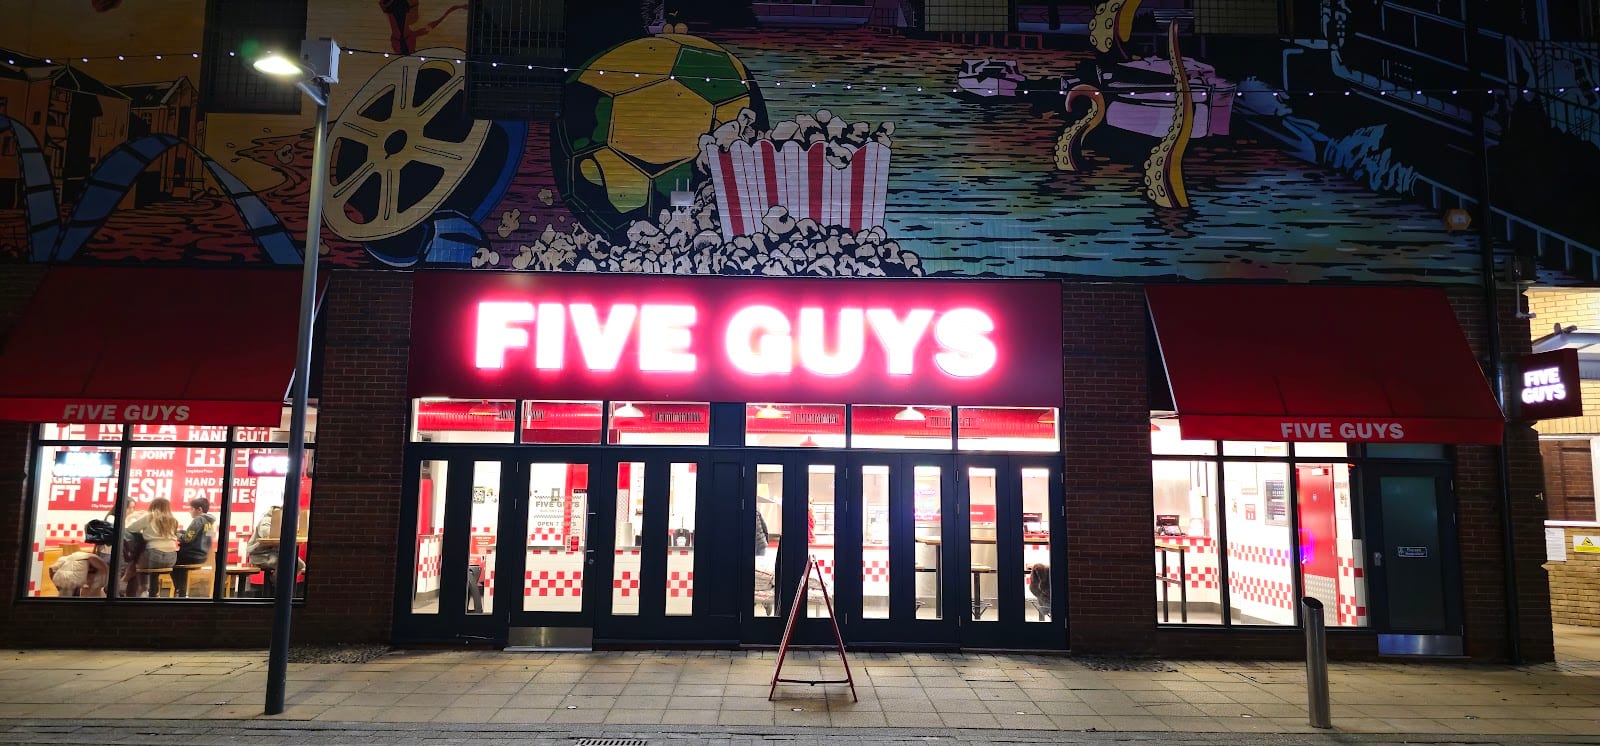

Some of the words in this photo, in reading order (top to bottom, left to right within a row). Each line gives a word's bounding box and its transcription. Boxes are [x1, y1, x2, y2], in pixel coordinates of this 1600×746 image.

[475, 302, 697, 372] FIVE
[725, 305, 998, 378] GUYS
[1524, 366, 1561, 387] FIVE
[1521, 382, 1567, 404] GUYS
[62, 404, 118, 420] FIVE
[123, 404, 190, 421] GUYS
[236, 431, 268, 442] CUT
[1280, 422, 1334, 439] FIVE
[1339, 422, 1405, 439] GUYS
[140, 451, 176, 460] JOINT
[145, 469, 174, 478] THAN
[184, 477, 216, 487] HAND
